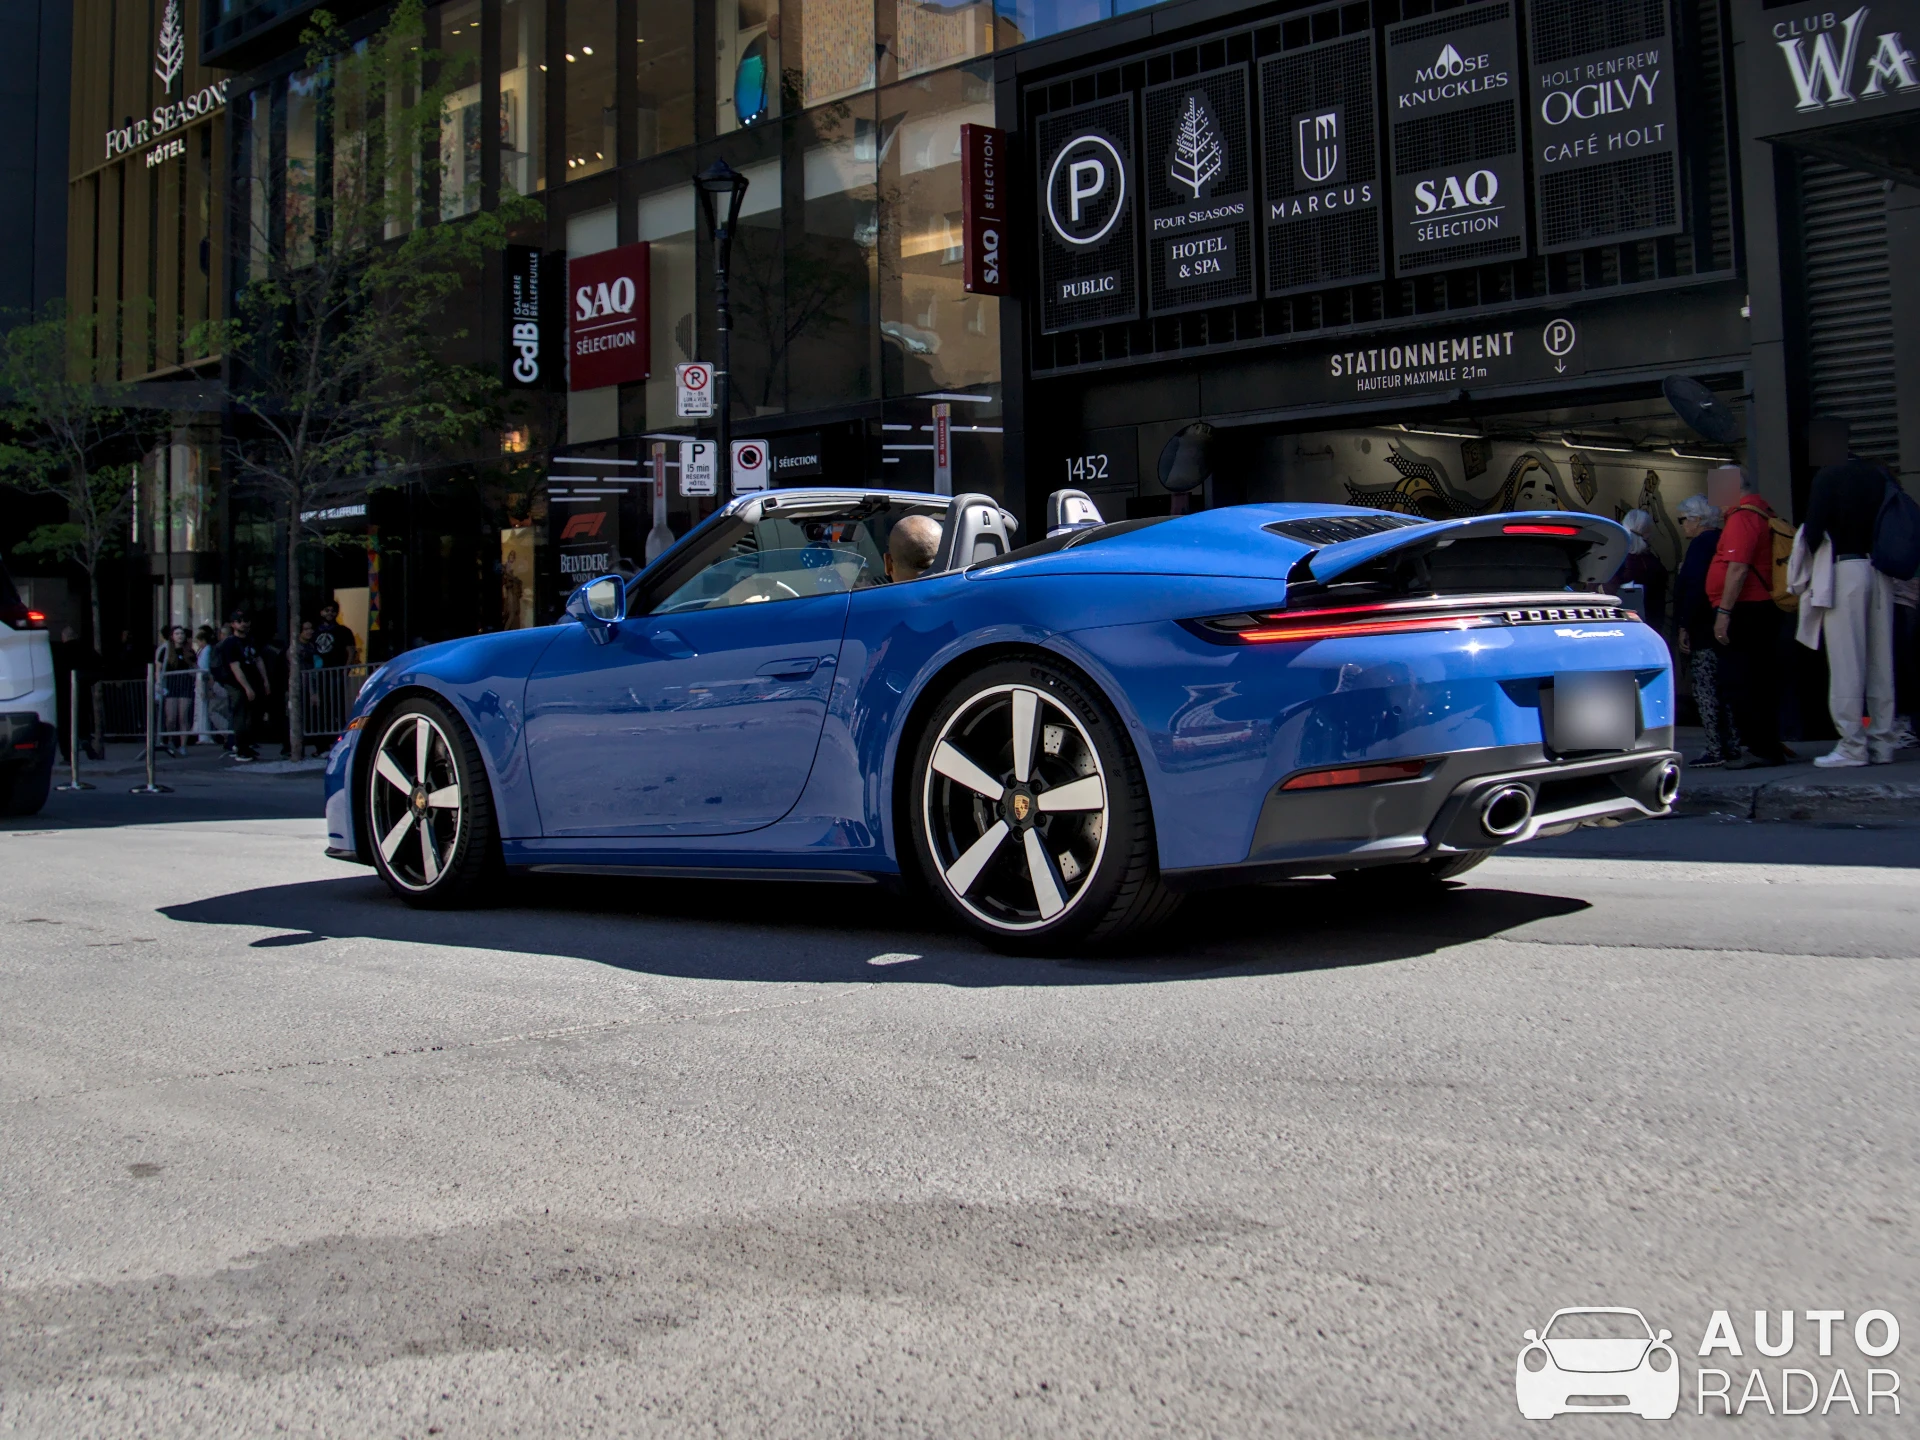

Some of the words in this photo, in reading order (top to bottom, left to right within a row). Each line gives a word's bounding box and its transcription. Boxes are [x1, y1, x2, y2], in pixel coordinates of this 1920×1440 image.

[1772, 12, 1836, 39] CLUB
[1415, 50, 1490, 83] MOOSE
[1542, 67, 1580, 88] HOLT
[1586, 50, 1659, 79] RENFREW
[1399, 72, 1508, 108] KNUCKLES
[1541, 70, 1660, 125] OGILVY
[105, 119, 150, 160] FOUR
[146, 139, 186, 168] HÔTEL
[1543, 133, 1599, 162] CAFÉ
[1608, 123, 1665, 151] HOLT
[983, 134, 995, 209] SÉLECTION
[1271, 185, 1372, 220] MARCUS
[1414, 169, 1498, 216] SAQ
[1153, 215, 1186, 231] FOUR
[1188, 203, 1245, 224] SEASONS
[1417, 215, 1499, 242] SÉLECTION
[982, 229, 999, 284] SAQ
[1171, 236, 1228, 260] HOTEL
[1178, 264, 1191, 278] &
[1194, 258, 1221, 276] SPA
[513, 275, 522, 315] GALERIE
[529, 252, 539, 317] BELLEFEUILLE
[575, 276, 636, 322] SAQ
[1062, 276, 1115, 299] PUBLIC
[521, 303, 530, 316] DE
[512, 322, 539, 383] GdB
[575, 330, 637, 356] SÉLECTION
[1331, 331, 1514, 377] STATIONNEMENT
[1357, 374, 1401, 391] HAUTEUR
[1404, 367, 1456, 386] MAXIMALE
[691, 443, 706, 463] P
[778, 455, 818, 468] SÉLECTION
[686, 464, 695, 473] 15
[696, 464, 710, 473] min
[1065, 454, 1109, 482] 1452
[560, 553, 609, 574] BELVEDERE
[1506, 608, 1616, 622] PORSCHE
